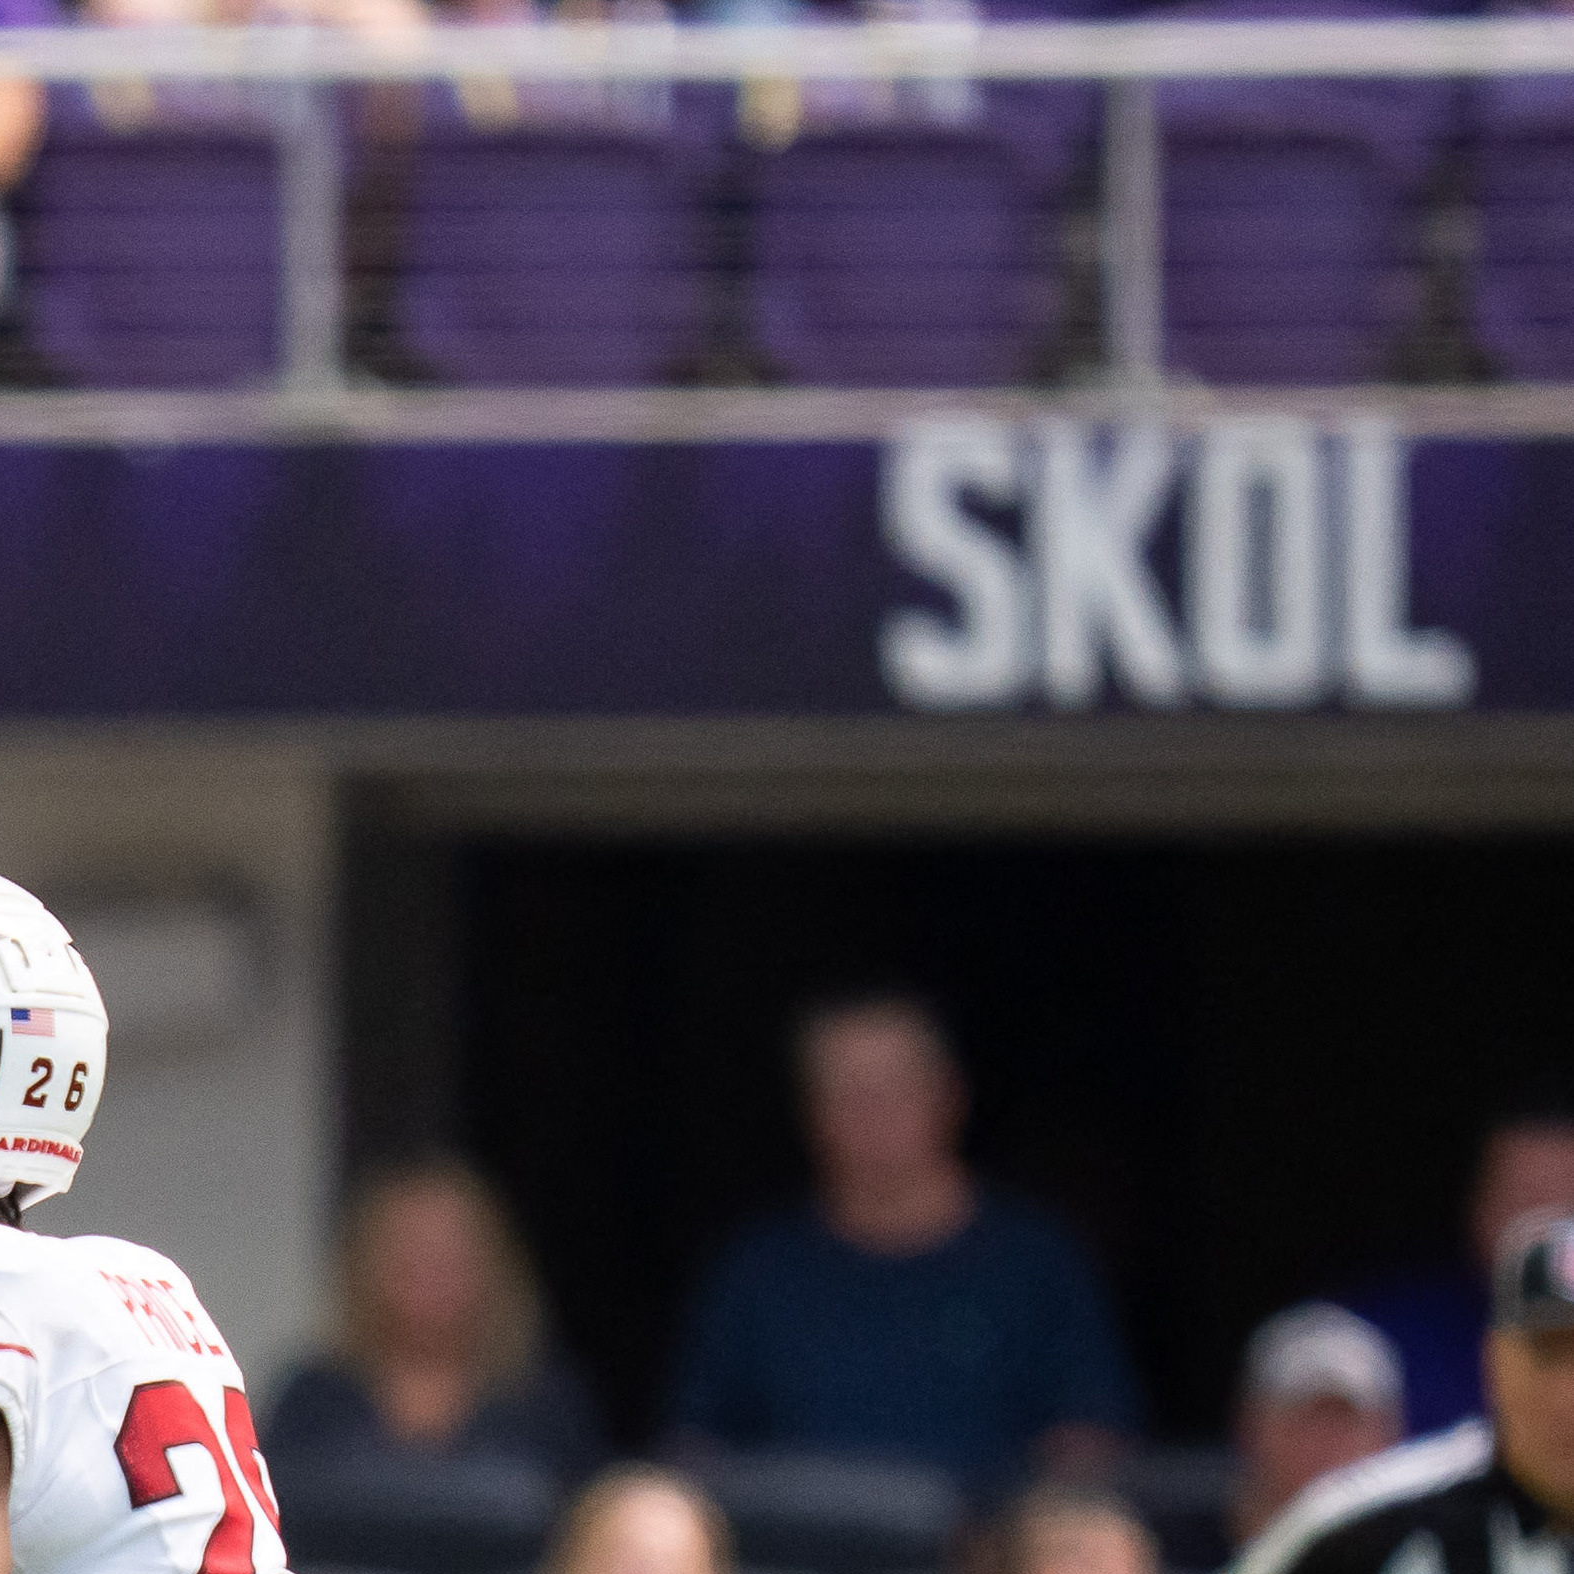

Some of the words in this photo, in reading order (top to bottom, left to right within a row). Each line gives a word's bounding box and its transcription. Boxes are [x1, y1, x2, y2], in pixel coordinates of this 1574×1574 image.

[880, 418, 1478, 710] SKOL
[22, 1056, 89, 1112] 26
[98, 1270, 224, 1356] PRICE
